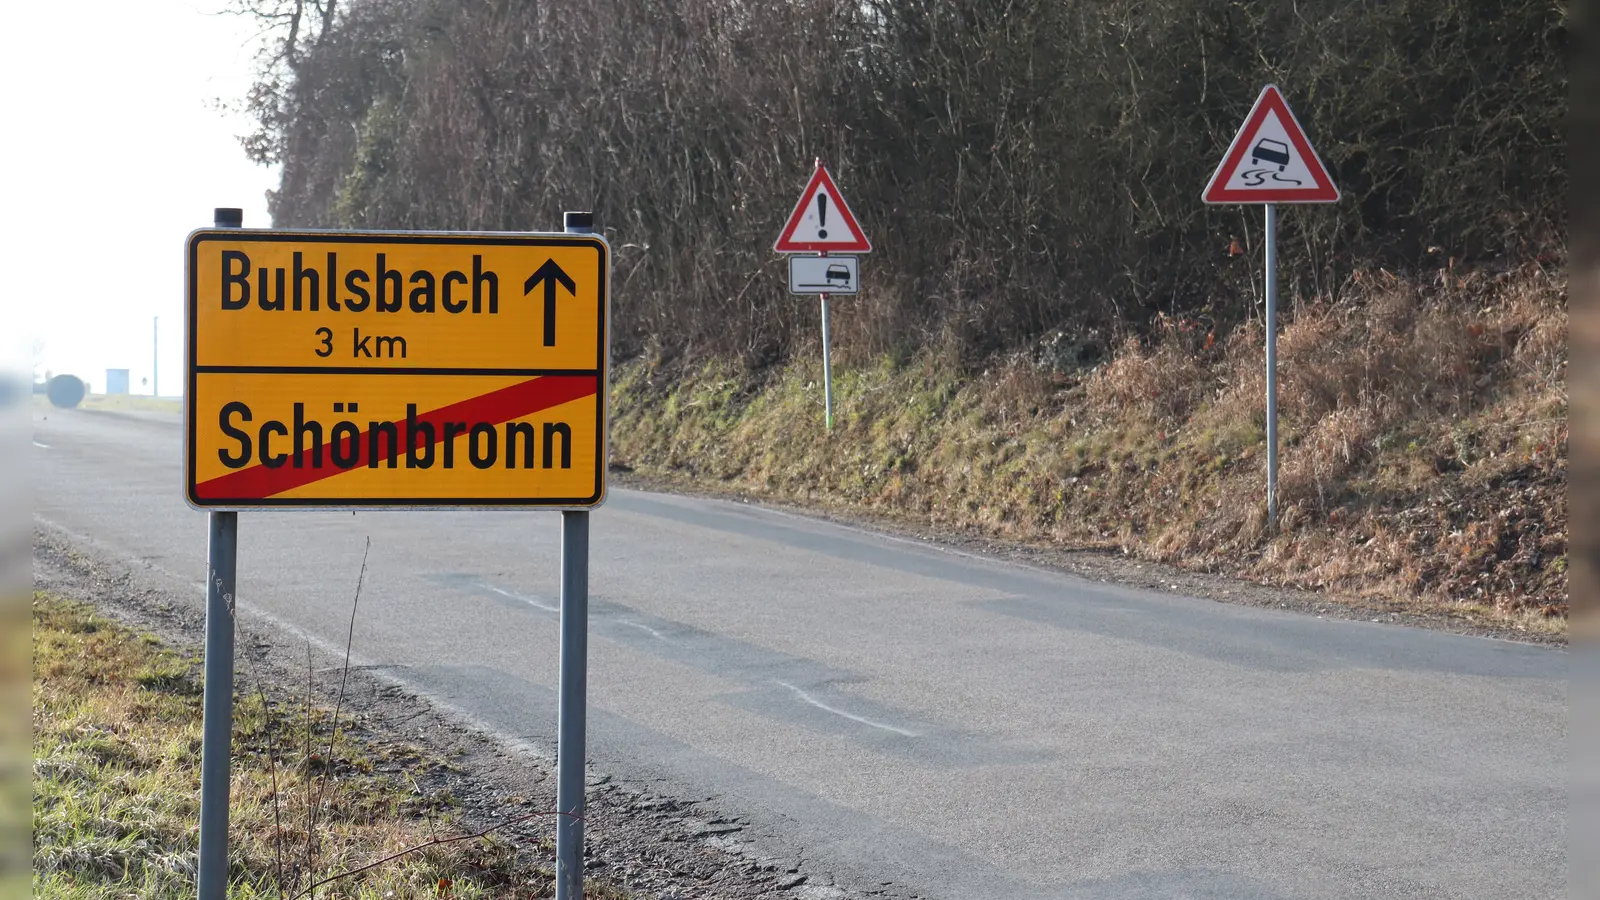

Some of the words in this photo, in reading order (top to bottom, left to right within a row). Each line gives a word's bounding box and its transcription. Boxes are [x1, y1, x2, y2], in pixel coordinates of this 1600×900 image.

[221, 250, 498, 314] Buhlsbach
[314, 326, 333, 358] 3
[353, 328, 407, 358] km
[218, 401, 571, 469] Schönbronn
